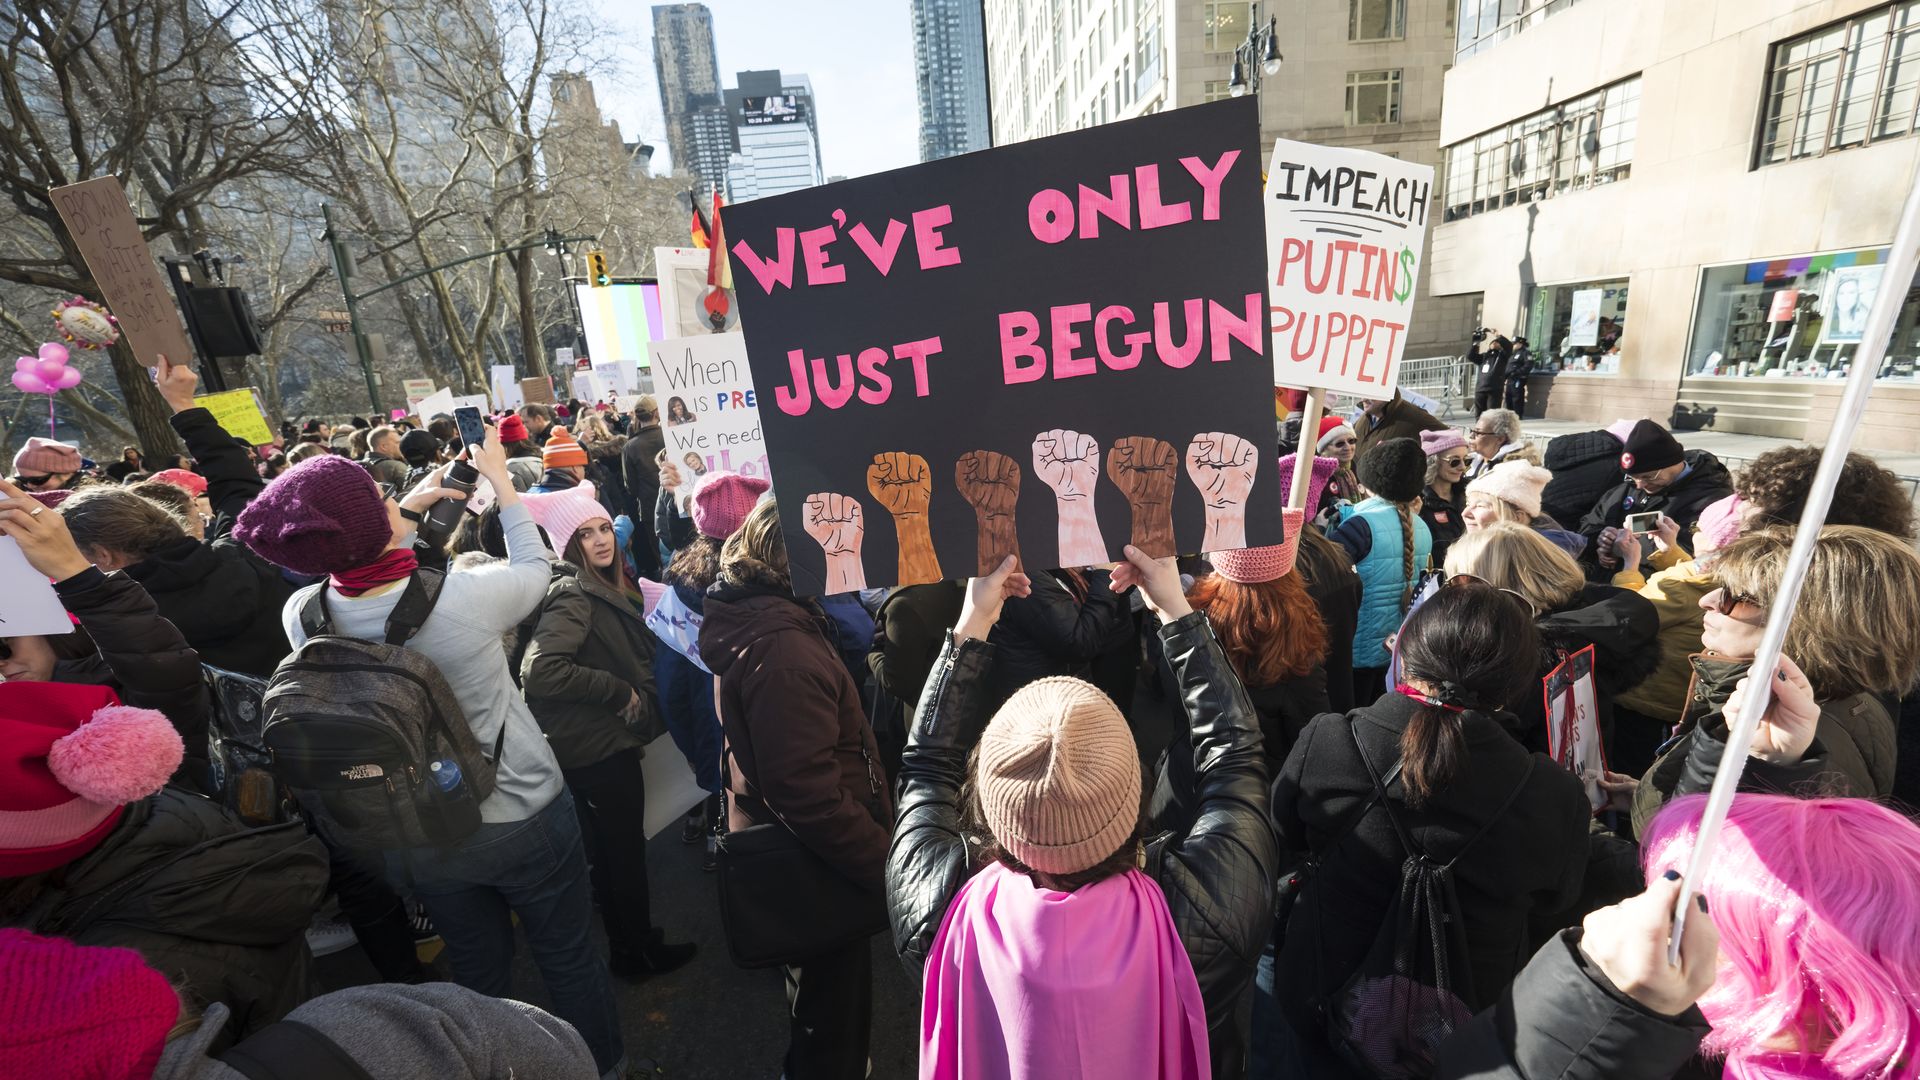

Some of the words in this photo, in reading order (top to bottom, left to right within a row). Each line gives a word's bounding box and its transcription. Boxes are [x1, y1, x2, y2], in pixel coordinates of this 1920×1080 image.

[61, 188, 127, 236] BROWN
[1276, 162, 1428, 225] IMPEACH
[733, 205, 961, 294] WE'VE
[1029, 150, 1241, 244] ONLY
[93, 245, 147, 281] WHITE
[1276, 238, 1415, 306] PUTIN$
[656, 347, 738, 390] When
[775, 336, 943, 416] JUST
[999, 293, 1263, 385] BEGUN
[671, 428, 710, 450] We
[717, 419, 762, 446] need
